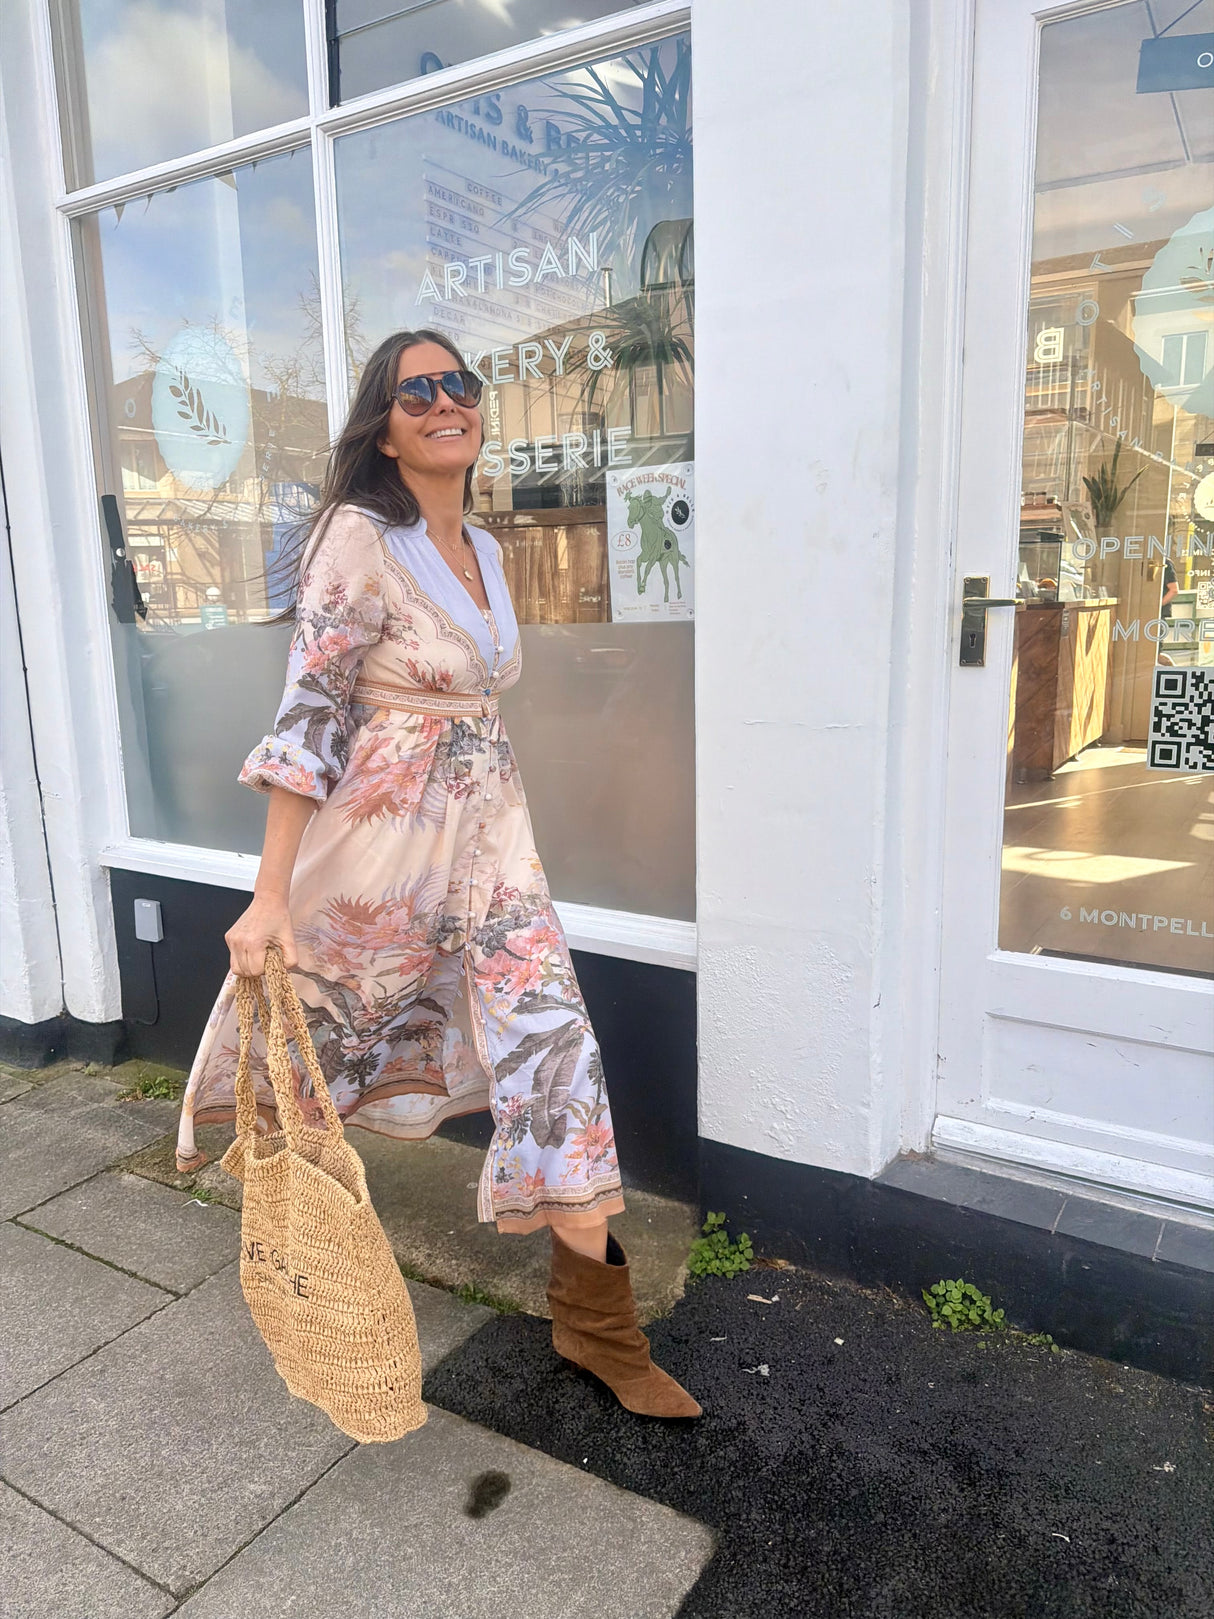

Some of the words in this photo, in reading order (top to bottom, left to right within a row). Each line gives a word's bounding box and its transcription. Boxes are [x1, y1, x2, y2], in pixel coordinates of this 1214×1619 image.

[435, 110, 497, 151] ARTISAN
[499, 140, 549, 176] BAKERY
[427, 185, 486, 217] AMERICANO
[466, 183, 503, 207] COFFEE
[414, 232, 599, 306] ARTISAN
[464, 335, 574, 387] KERY
[587, 331, 615, 371] &
[471, 426, 633, 479] SSERIE
[616, 477, 637, 497] RACE
[658, 472, 687, 490] SPECIAL
[616, 533, 632, 548] £8
[1060, 906, 1073, 921] 6
[1079, 907, 1214, 938] MONTPELL
